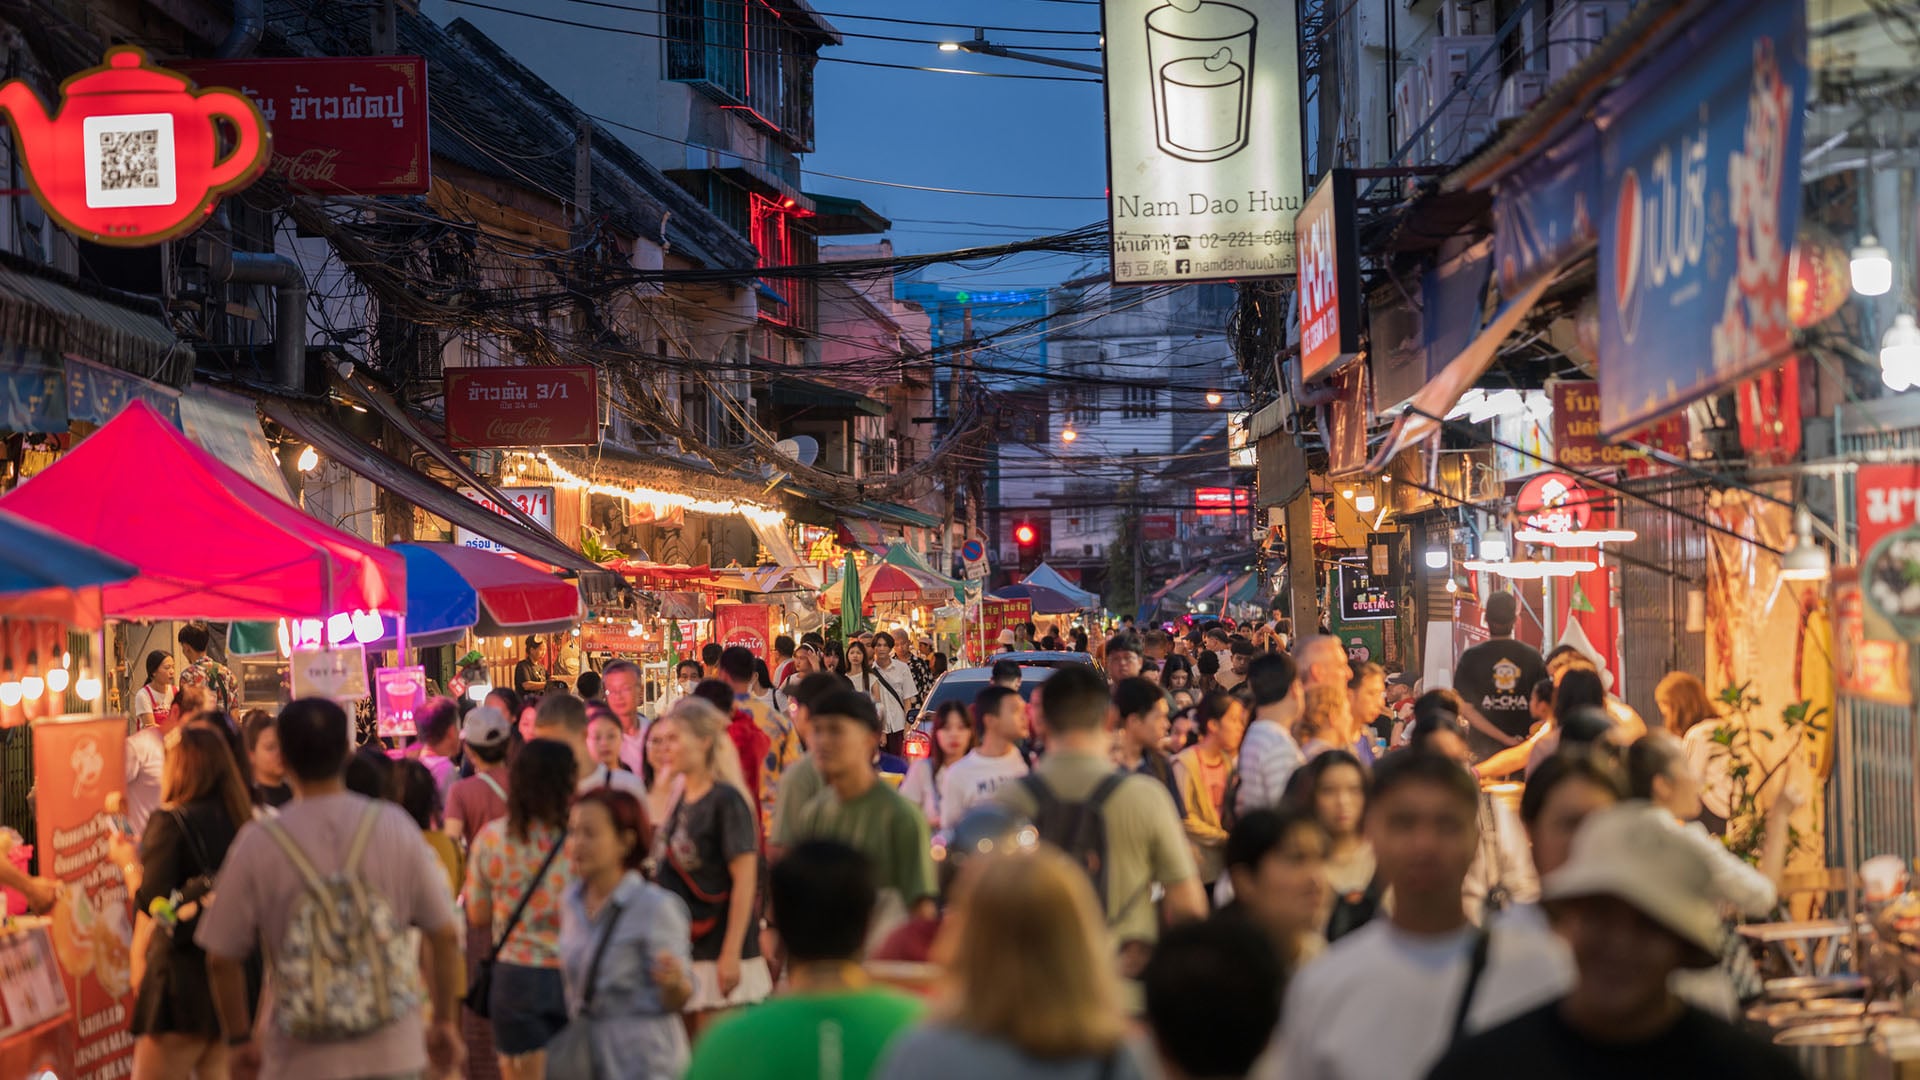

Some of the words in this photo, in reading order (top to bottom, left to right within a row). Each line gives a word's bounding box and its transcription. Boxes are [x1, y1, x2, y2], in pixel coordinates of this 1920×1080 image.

[290, 83, 404, 128] ข้าวผัดปู
[1117, 194, 1180, 218] Nam
[1188, 192, 1239, 215] Dao
[1247, 190, 1299, 212] Huu
[1116, 260, 1169, 278] 南豆腐
[468, 380, 528, 400] ข้าวต้ม
[536, 383, 568, 399] 3/1
[517, 494, 547, 516] 3/1
[1352, 600, 1395, 610] COCKTAILS
